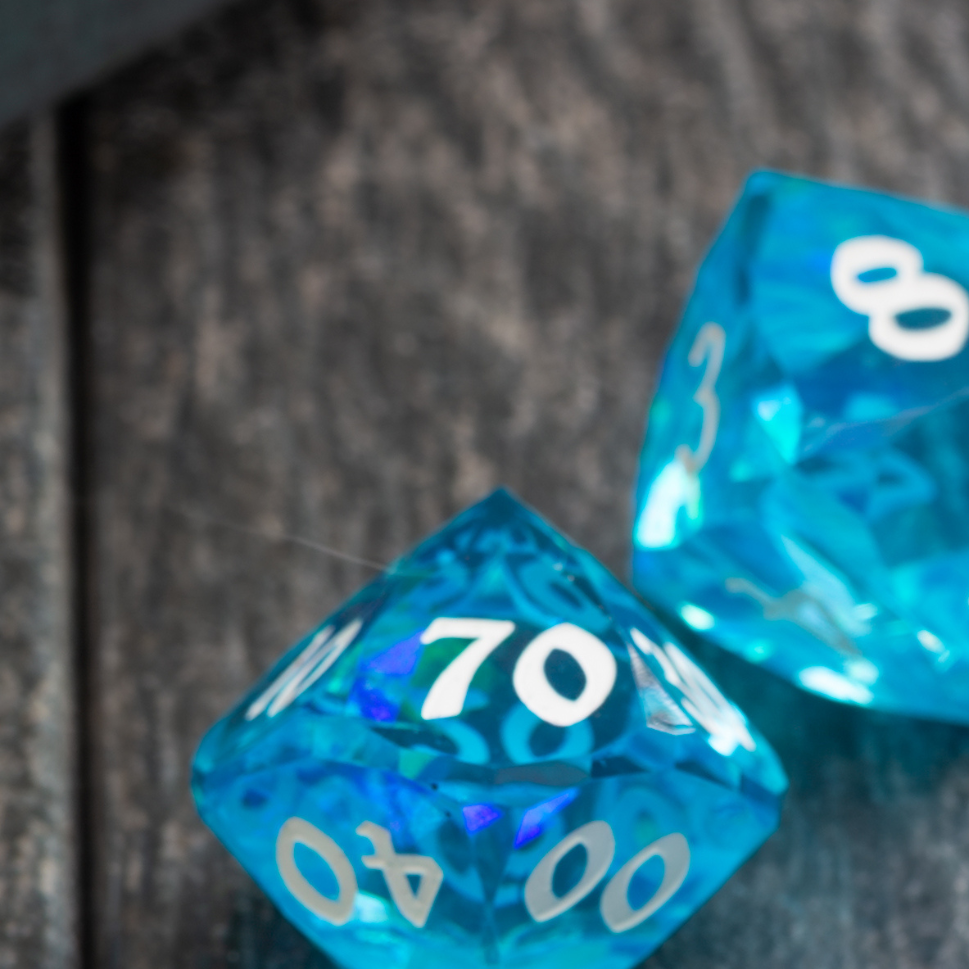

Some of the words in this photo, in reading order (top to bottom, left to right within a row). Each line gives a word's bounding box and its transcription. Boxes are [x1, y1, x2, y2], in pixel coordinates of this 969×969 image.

[420, 616, 617, 728] 70
[275, 816, 444, 928] 40
[524, 820, 691, 934] 00
